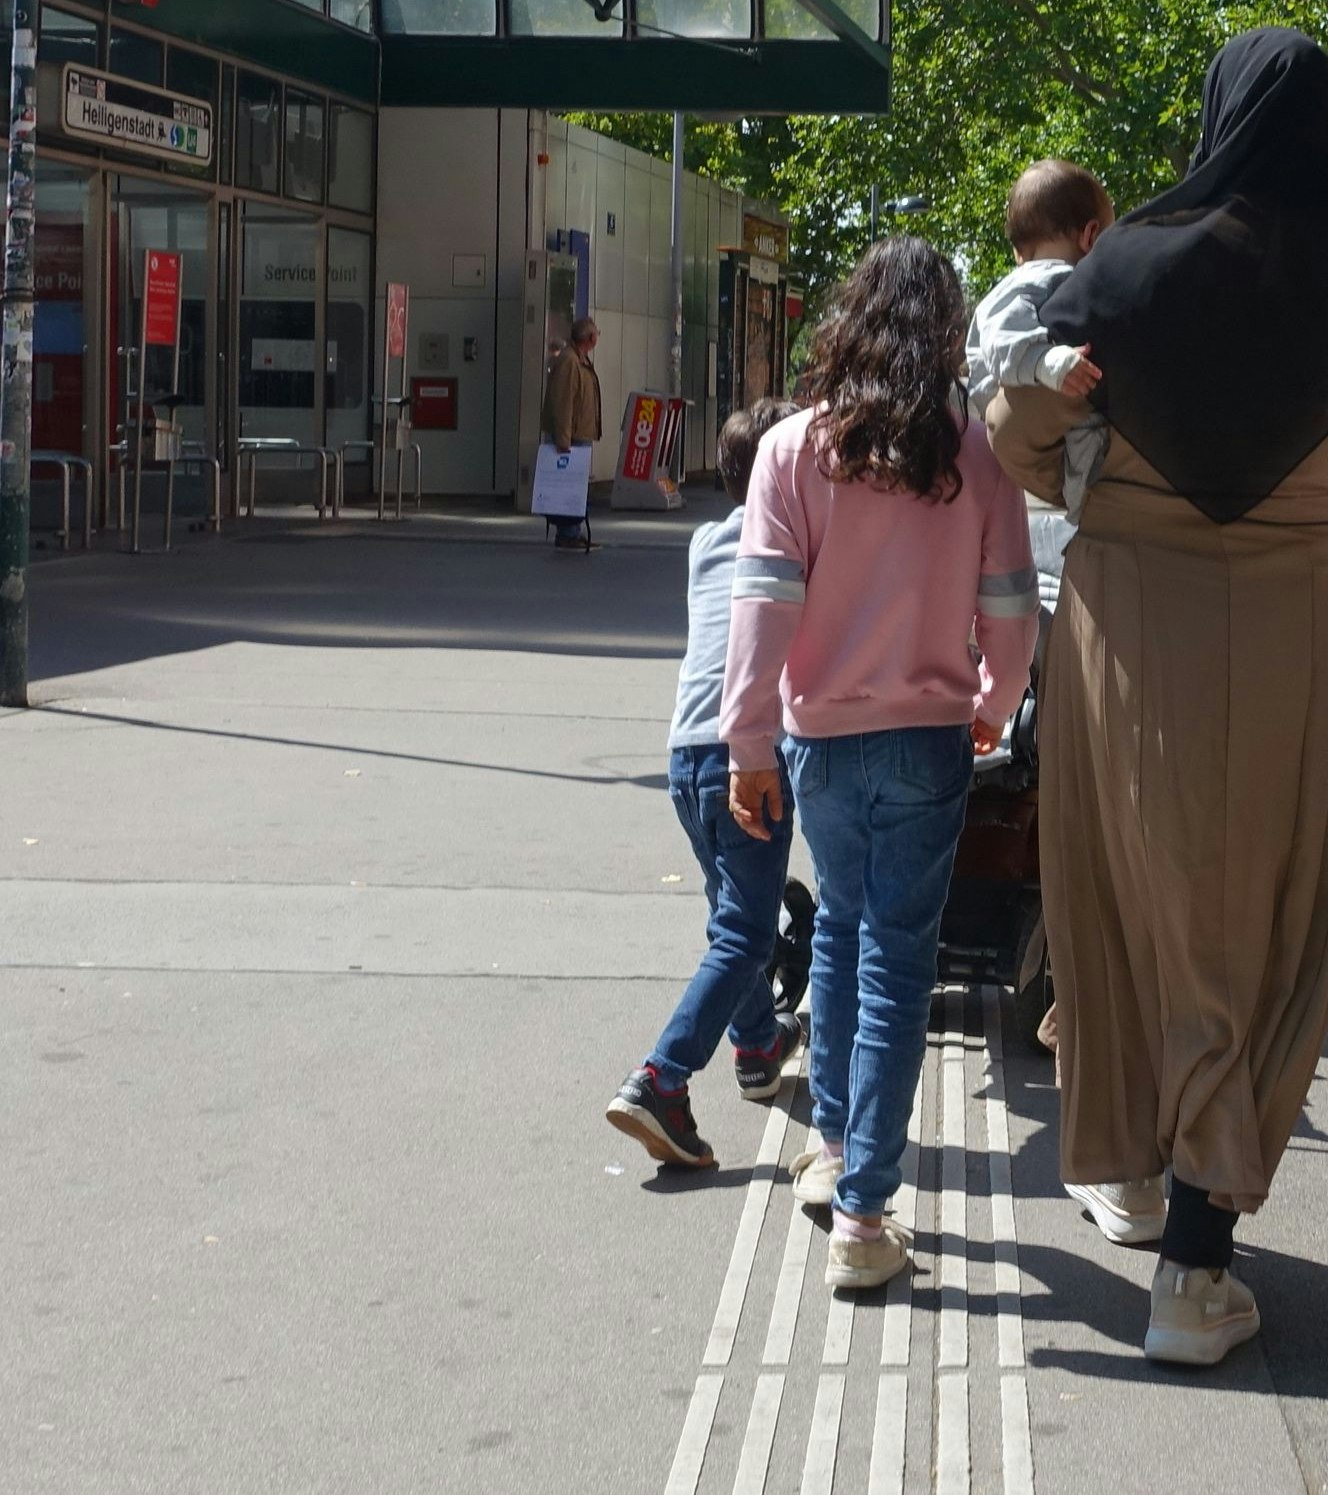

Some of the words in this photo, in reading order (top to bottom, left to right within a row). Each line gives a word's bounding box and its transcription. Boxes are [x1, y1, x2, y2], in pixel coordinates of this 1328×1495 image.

[82, 100, 155, 139] Heiligenstadt
[58, 272, 81, 290] Poi
[264, 263, 316, 281] Service
[328, 264, 357, 282] oint
[635, 398, 657, 449] oe24
